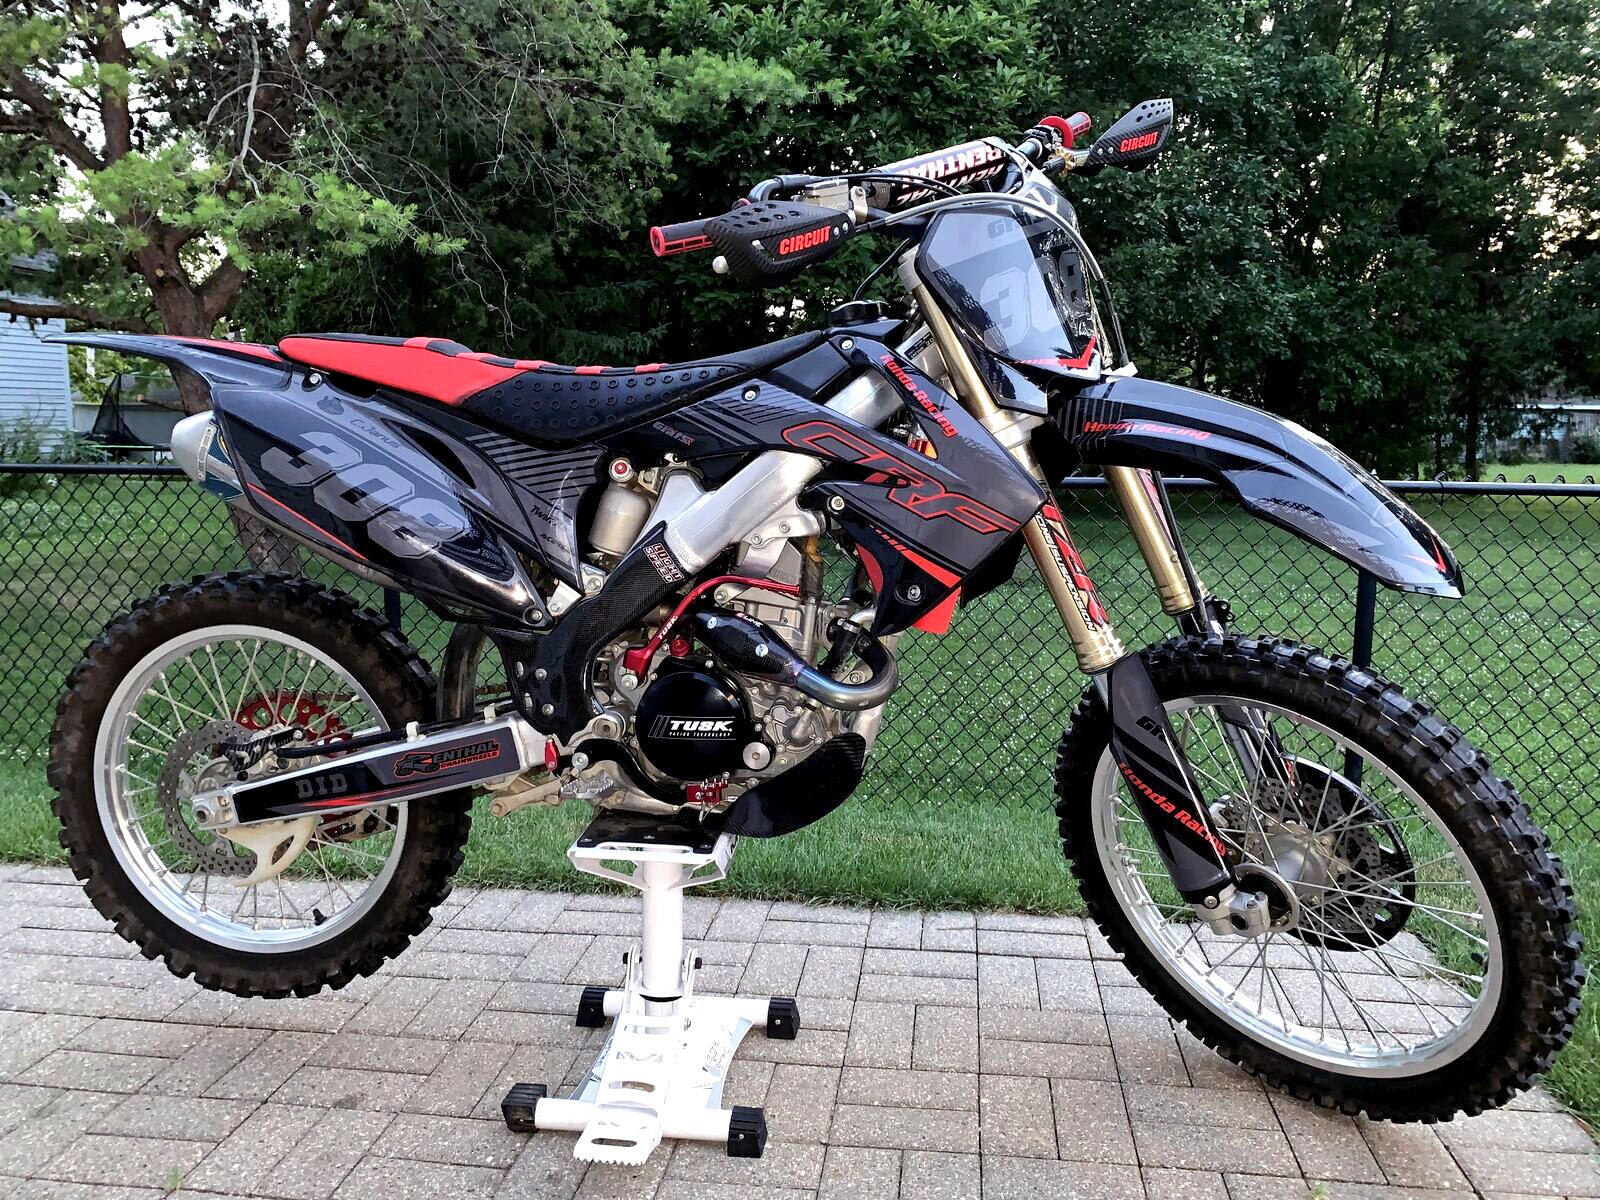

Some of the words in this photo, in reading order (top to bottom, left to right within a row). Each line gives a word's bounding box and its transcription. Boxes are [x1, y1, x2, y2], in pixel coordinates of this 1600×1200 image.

[1119, 131, 1159, 153] CIRCUIT
[779, 225, 831, 255] CIRCUIT
[880, 354, 917, 391] Honda
[913, 390, 959, 439] Racing
[1139, 423, 1213, 441] Racing
[781, 419, 1023, 535] CRF
[260, 431, 471, 560] 308
[645, 547, 673, 582] SPEED
[654, 544, 682, 579] LIGHT
[394, 740, 499, 778] RENTHAL
[1119, 762, 1176, 814] Honda
